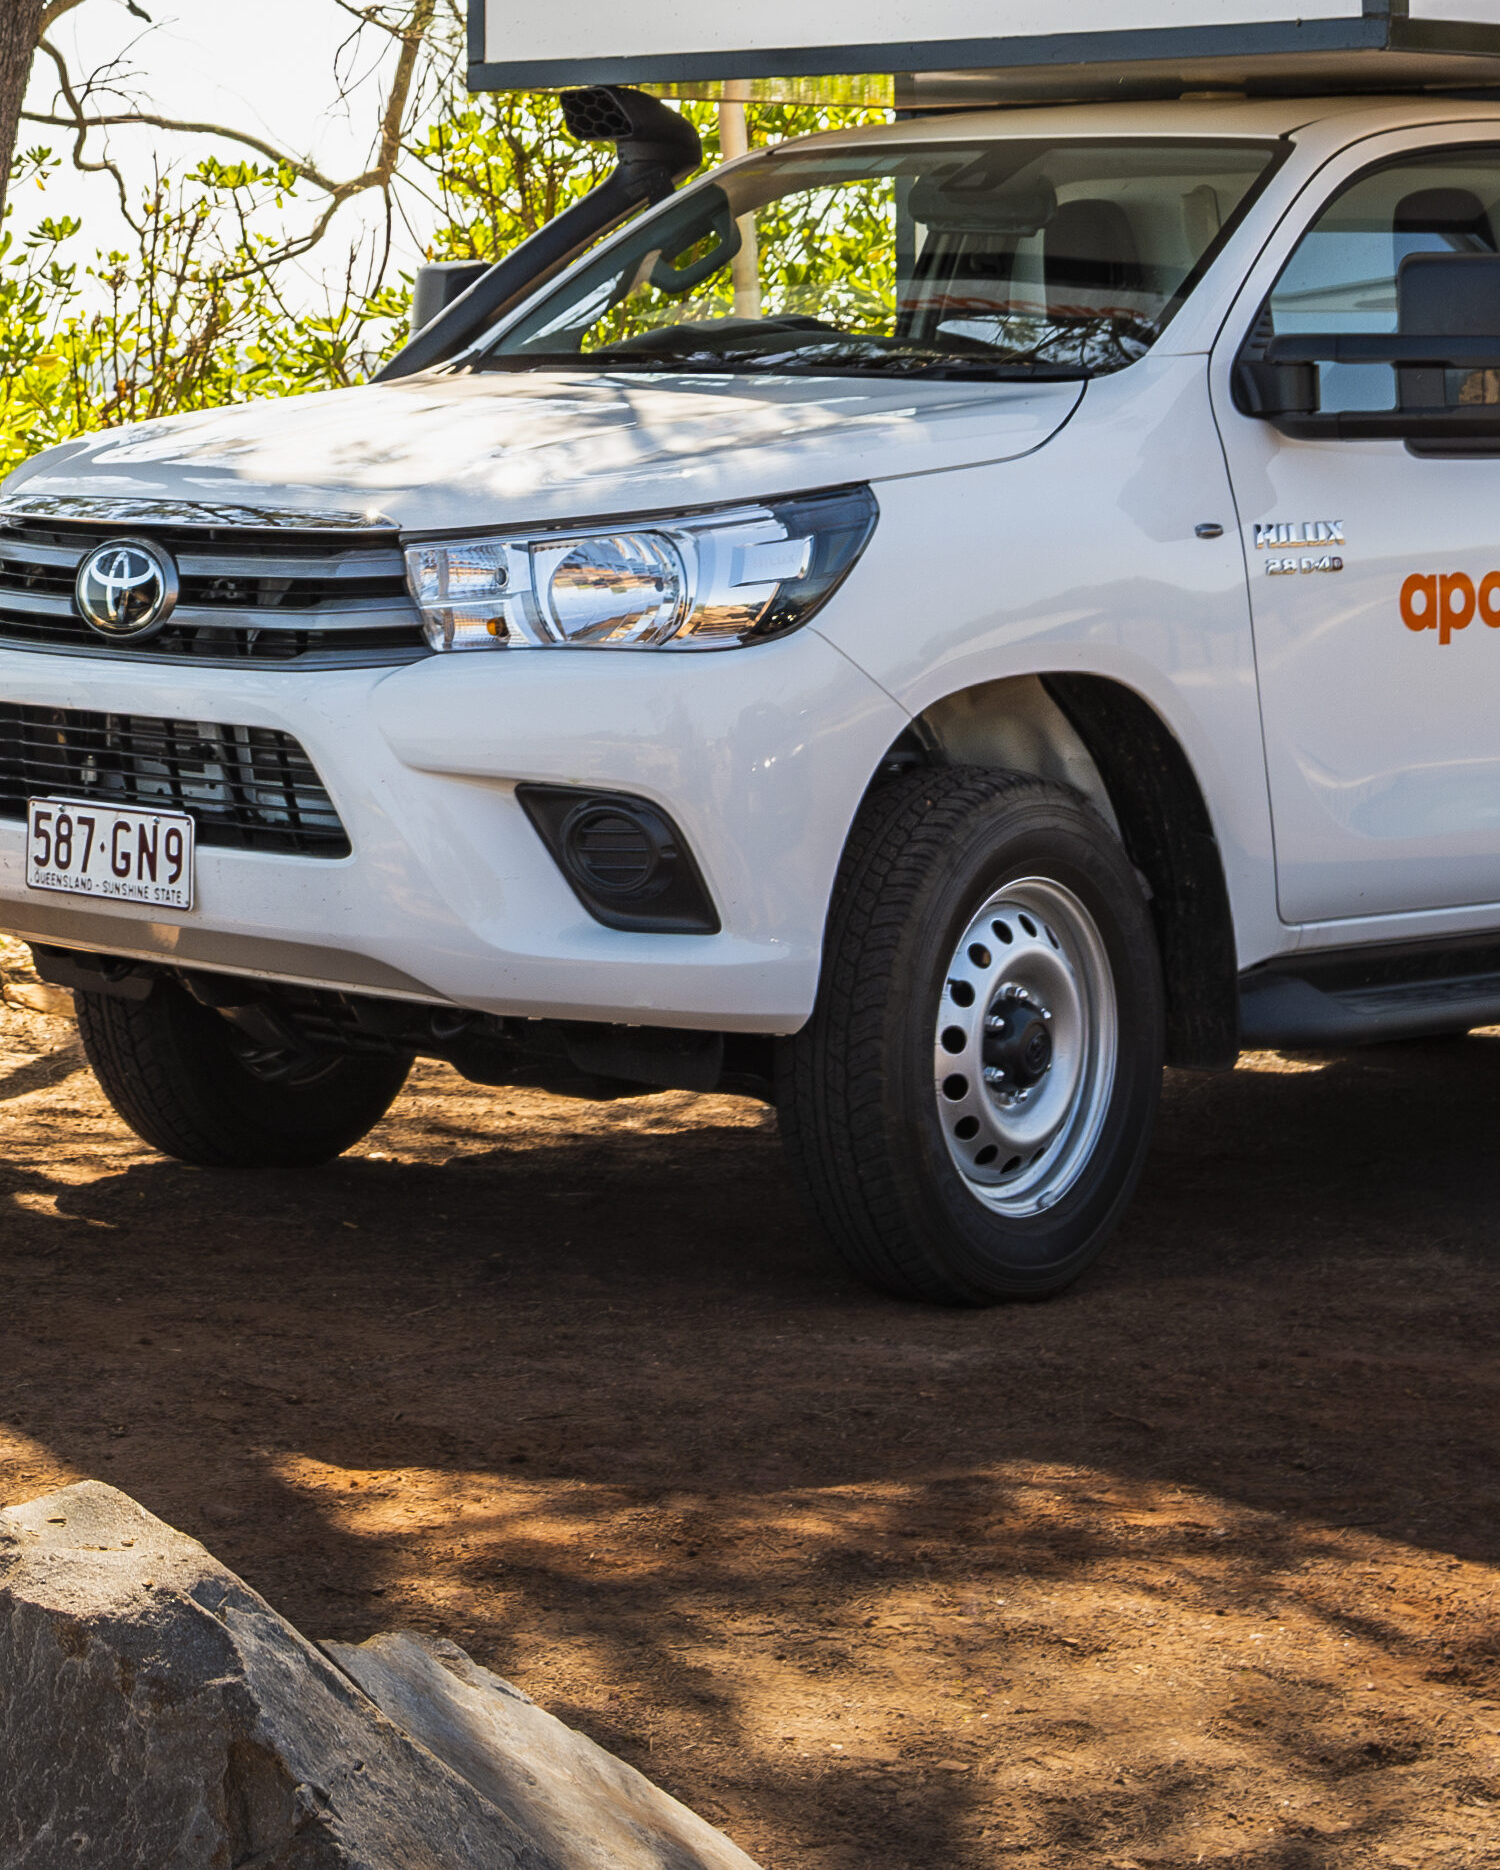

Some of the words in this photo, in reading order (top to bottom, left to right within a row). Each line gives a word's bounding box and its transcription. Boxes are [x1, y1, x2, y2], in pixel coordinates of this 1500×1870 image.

[1253, 519, 1345, 549] HILUX
[34, 870, 93, 891] QUEENSLAND
[102, 880, 150, 900] SUNSHINE
[154, 888, 182, 904] STATE
